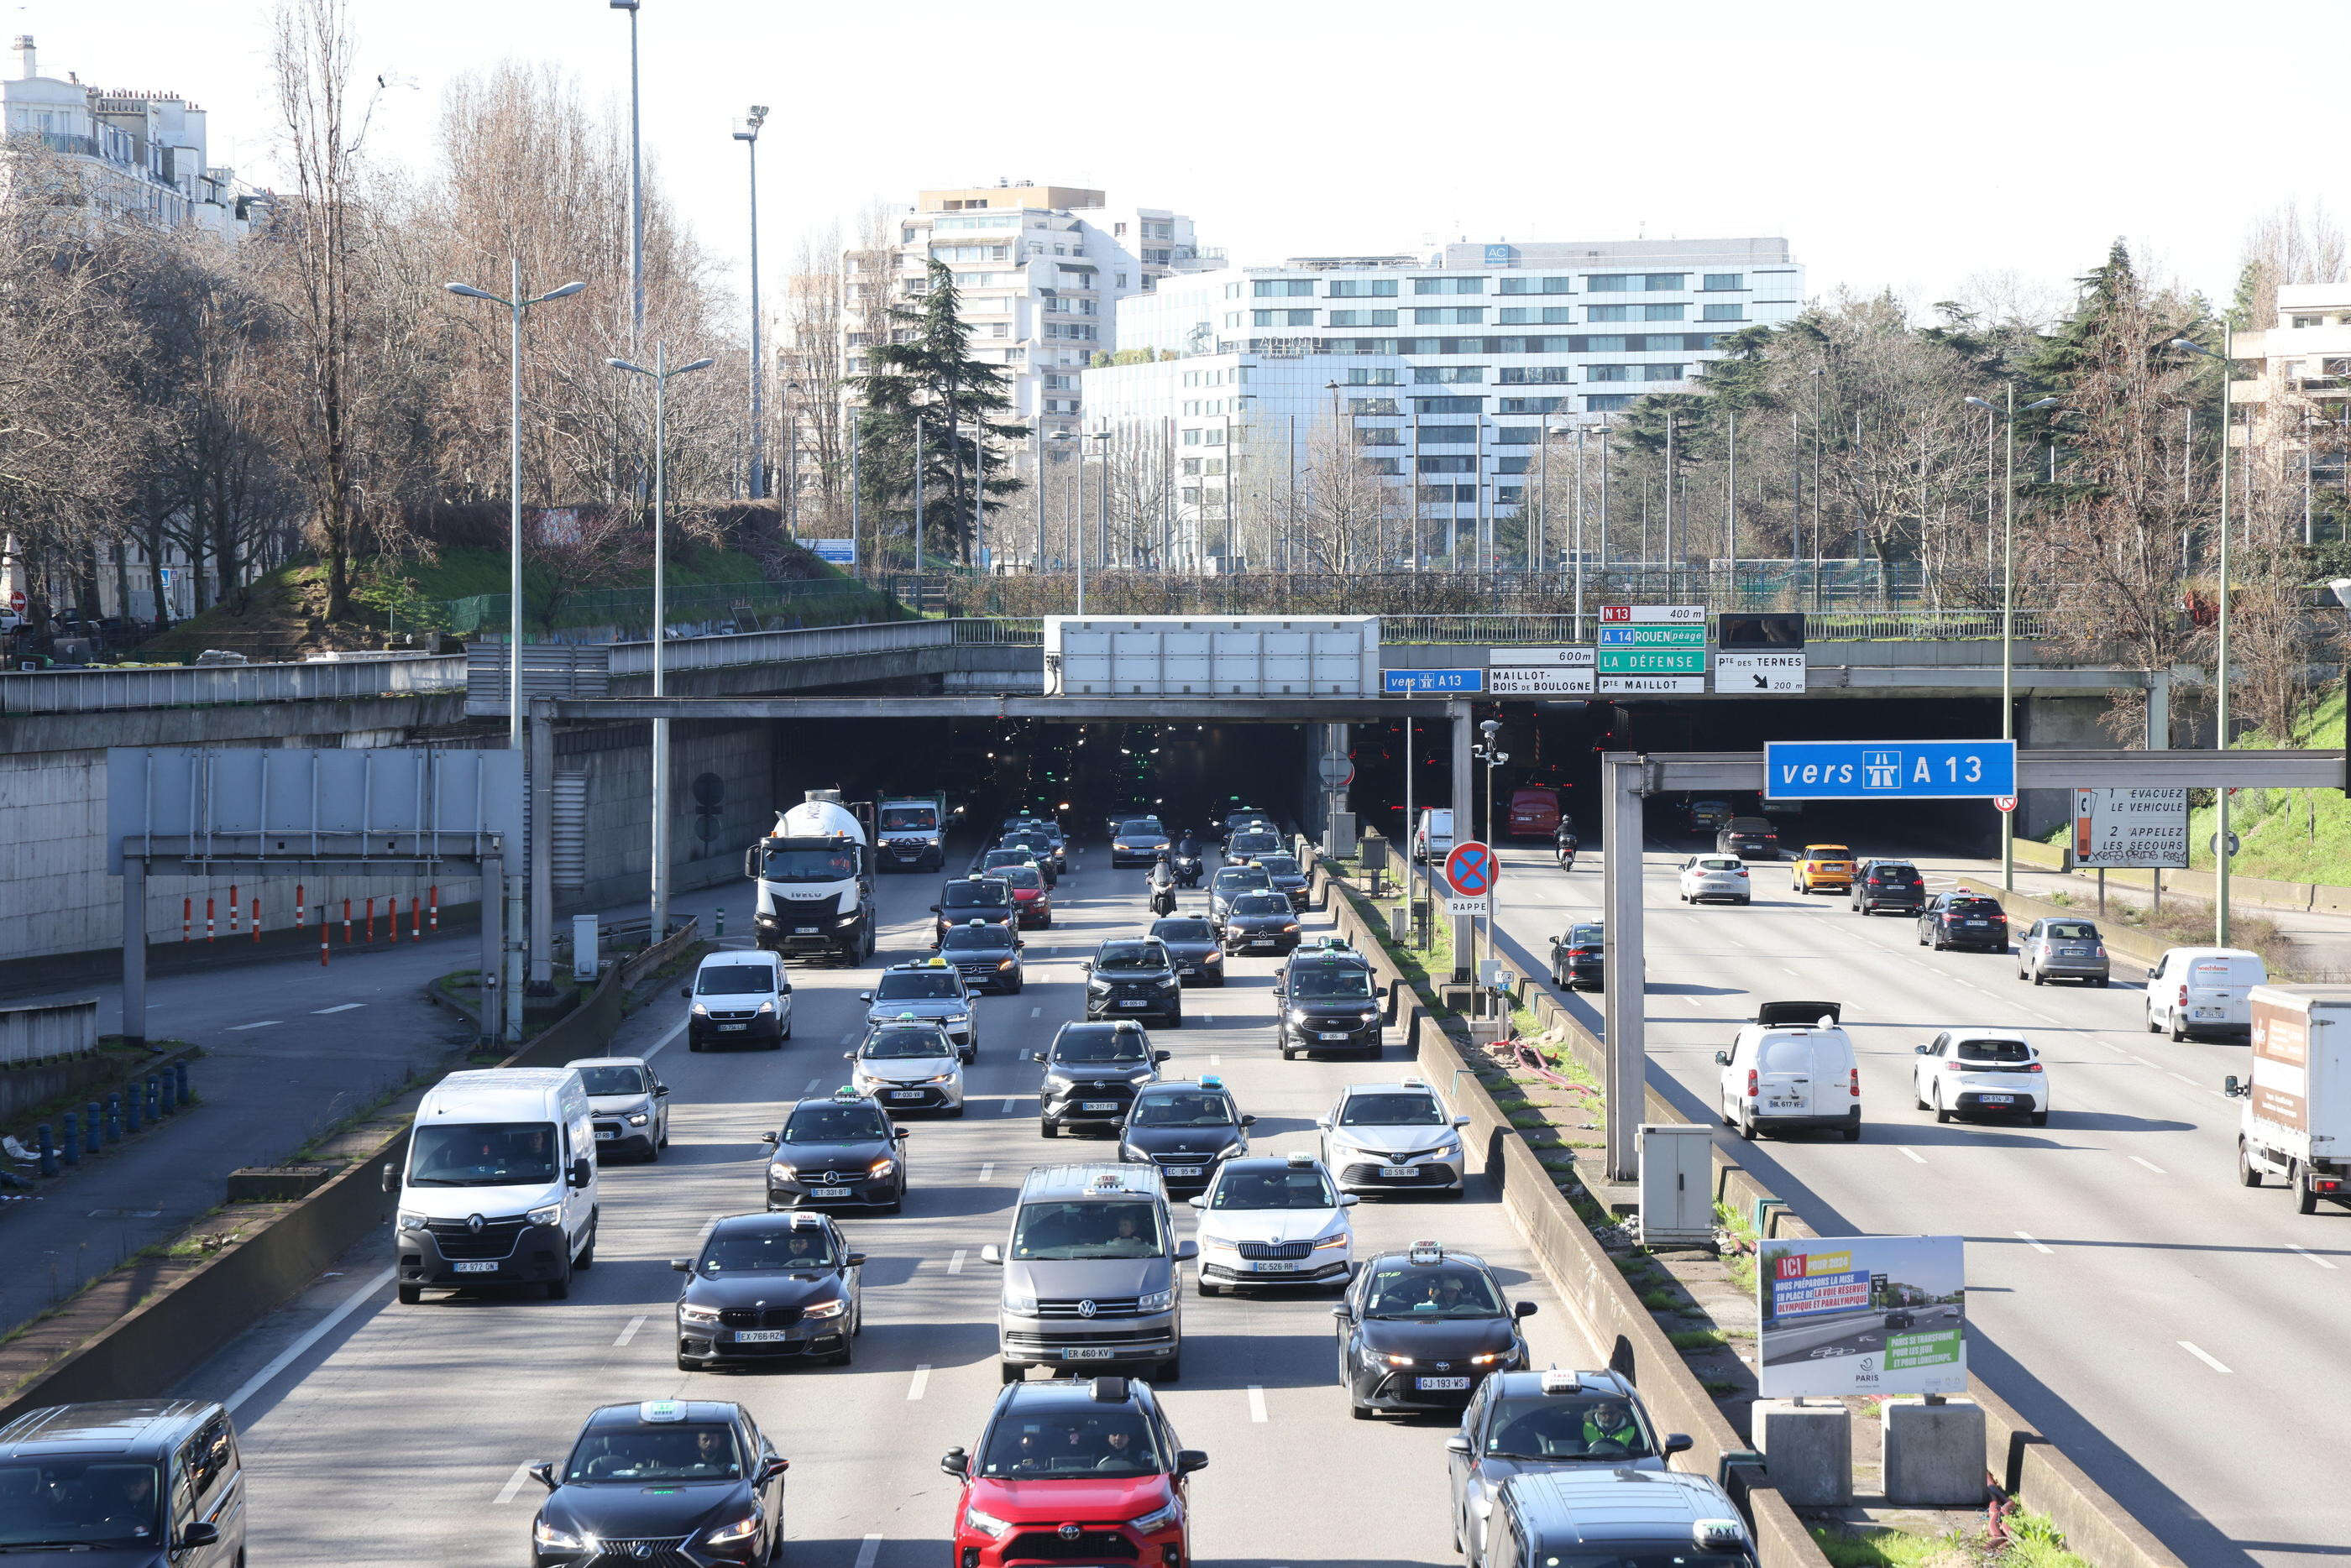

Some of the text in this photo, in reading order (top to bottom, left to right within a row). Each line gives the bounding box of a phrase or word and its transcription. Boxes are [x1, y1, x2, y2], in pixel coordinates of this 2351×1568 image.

[1488, 248, 1505, 258] AC
[1605, 609, 1612, 619] N
[1616, 609, 1628, 619] 13
[1669, 609, 1689, 619] 400
[1604, 631, 1702, 642] A 14 ROUEN péage
[1604, 654, 1693, 667] LA DÉFENSE
[1757, 658, 1802, 666] TERNES
[1391, 675, 1462, 687] vers A 13
[1625, 681, 1678, 689] MAILLOT
[1773, 682, 1792, 690] 200
[1493, 682, 1518, 691] BOIS
[1534, 682, 1591, 691] BOULOGNE
[1783, 755, 1982, 784] vers A 13
[2110, 789, 2183, 798] 1 EVACUEZ
[2111, 802, 2183, 812] LE VEHICULE
[2110, 826, 2183, 837] 2 APPELEZ
[2102, 841, 2183, 850] LES SECOURS
[1783, 1257, 1847, 1276] ICI POUR 2024
[1775, 1283, 1793, 1291] NOUS
[1793, 1278, 1829, 1289] PRÉPARONS
[1839, 1274, 1854, 1283] MISE
[1777, 1283, 1867, 1302] EN PLACE DE LA VOIE RÉSERVÉE
[1778, 1302, 1812, 1313] OLYMPIQUE
[1821, 1294, 1867, 1308] PARALYMPIQUE
[1891, 1336, 1908, 1347] PARIS
[1893, 1345, 1933, 1358] POUR LES JEUX
[1893, 1359, 1900, 1368] ET
[1708, 1528, 1736, 1536] TAXI
